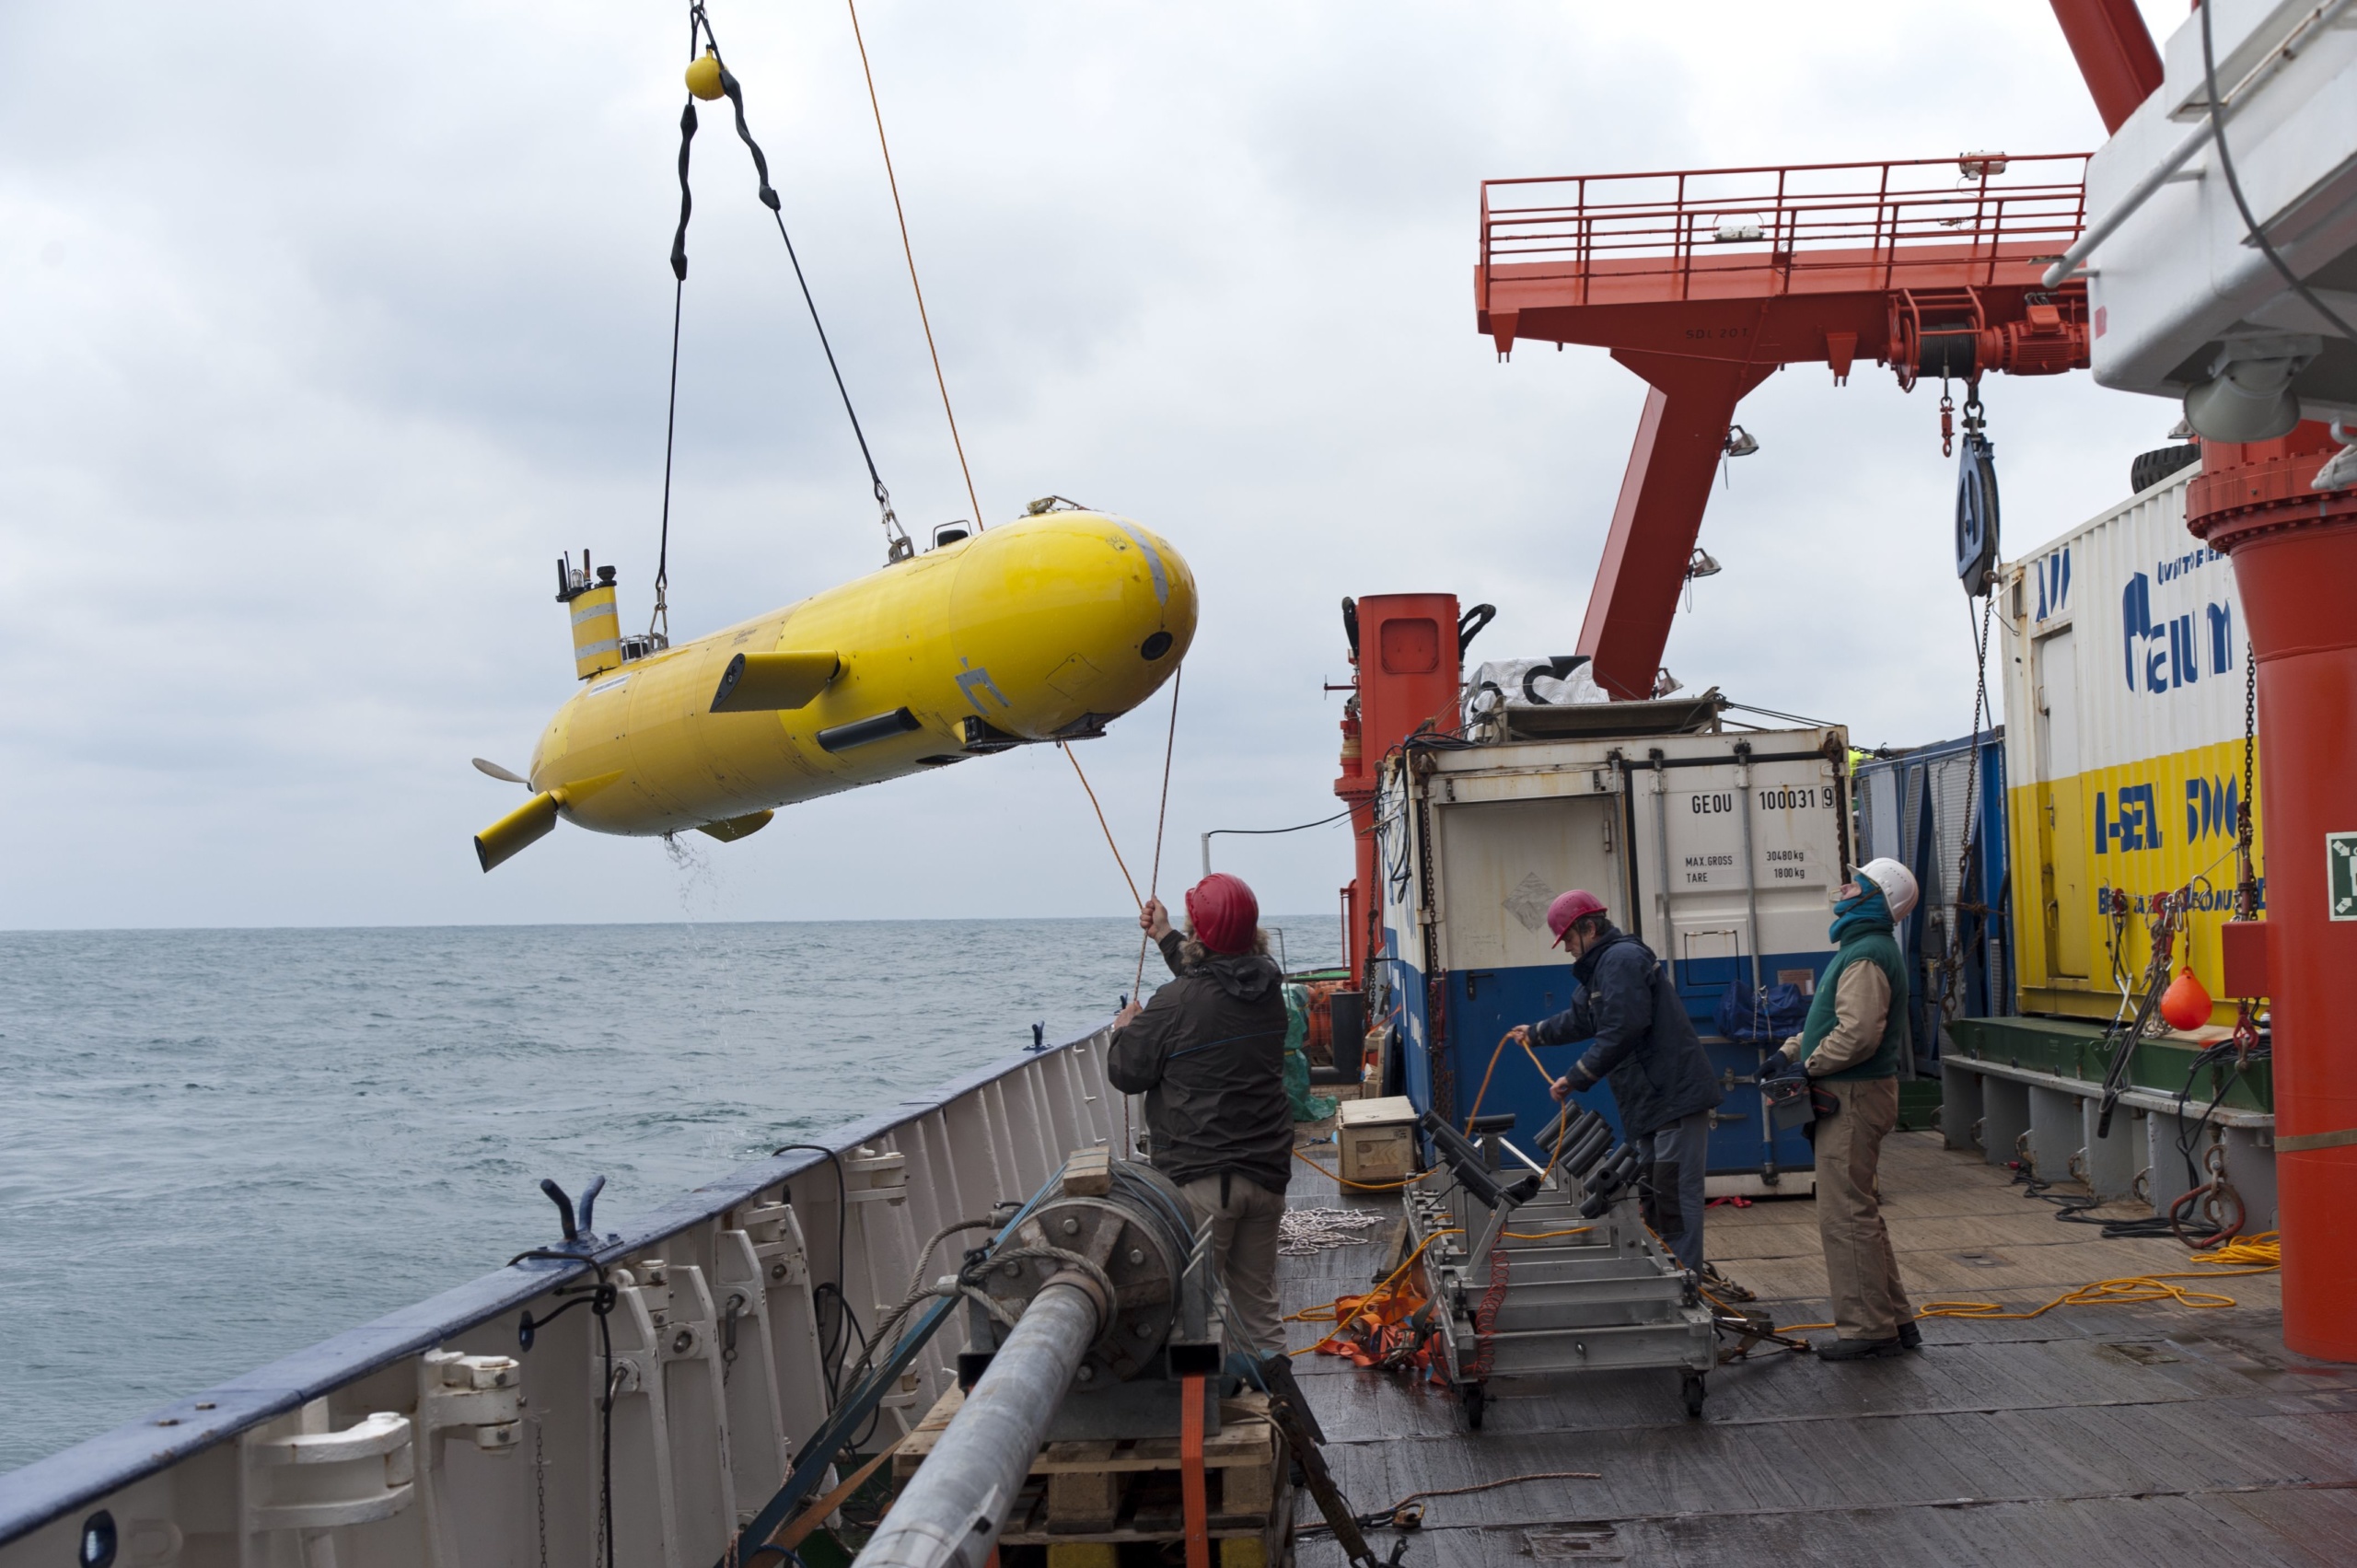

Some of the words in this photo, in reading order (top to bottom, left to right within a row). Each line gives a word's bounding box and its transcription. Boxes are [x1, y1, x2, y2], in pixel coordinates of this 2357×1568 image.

[1692, 794, 1732, 814] GEOU
[1759, 789, 1816, 810] 100031
[1822, 787, 1835, 808] 9
[1687, 873, 1708, 883] TARE
